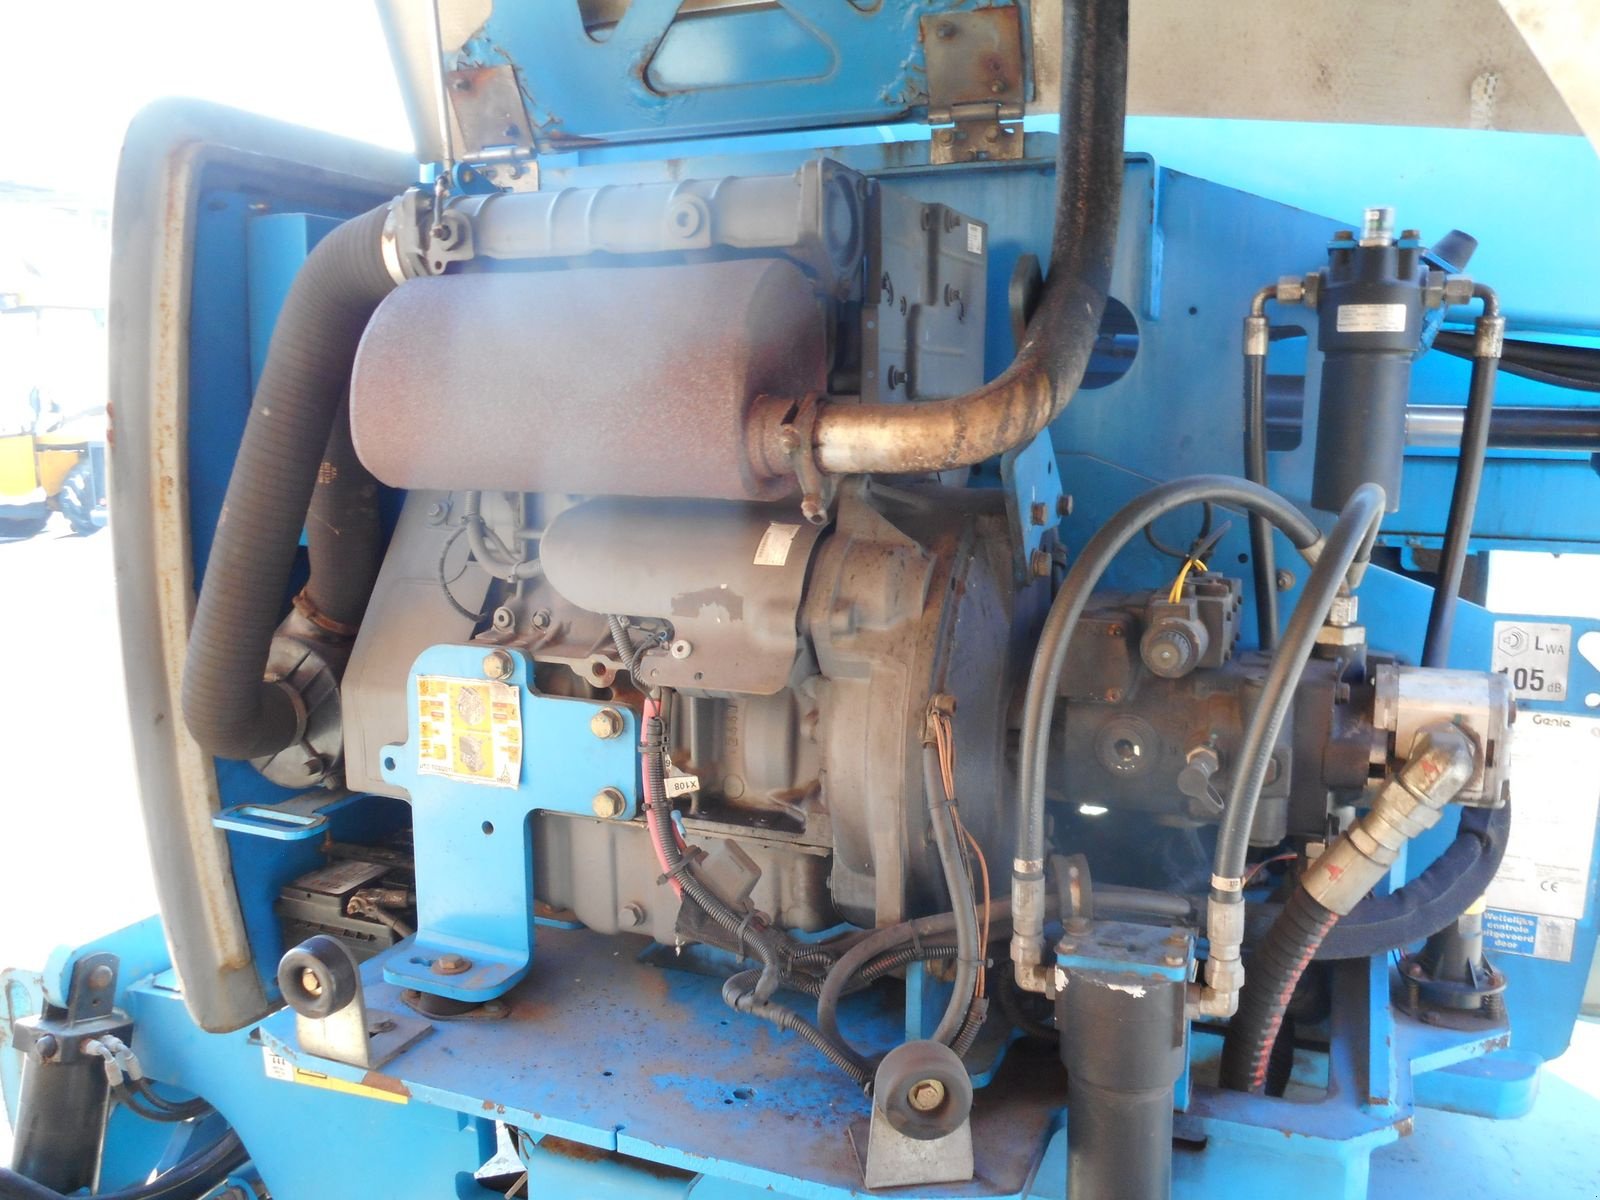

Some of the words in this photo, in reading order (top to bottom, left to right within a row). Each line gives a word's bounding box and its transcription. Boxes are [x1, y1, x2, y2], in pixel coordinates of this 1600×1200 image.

[1547, 682, 1562, 693] dB
[1532, 714, 1571, 727] Genie
[674, 781, 697, 790] X108
[1486, 922, 1529, 934] controle
[1494, 939, 1518, 949] door
